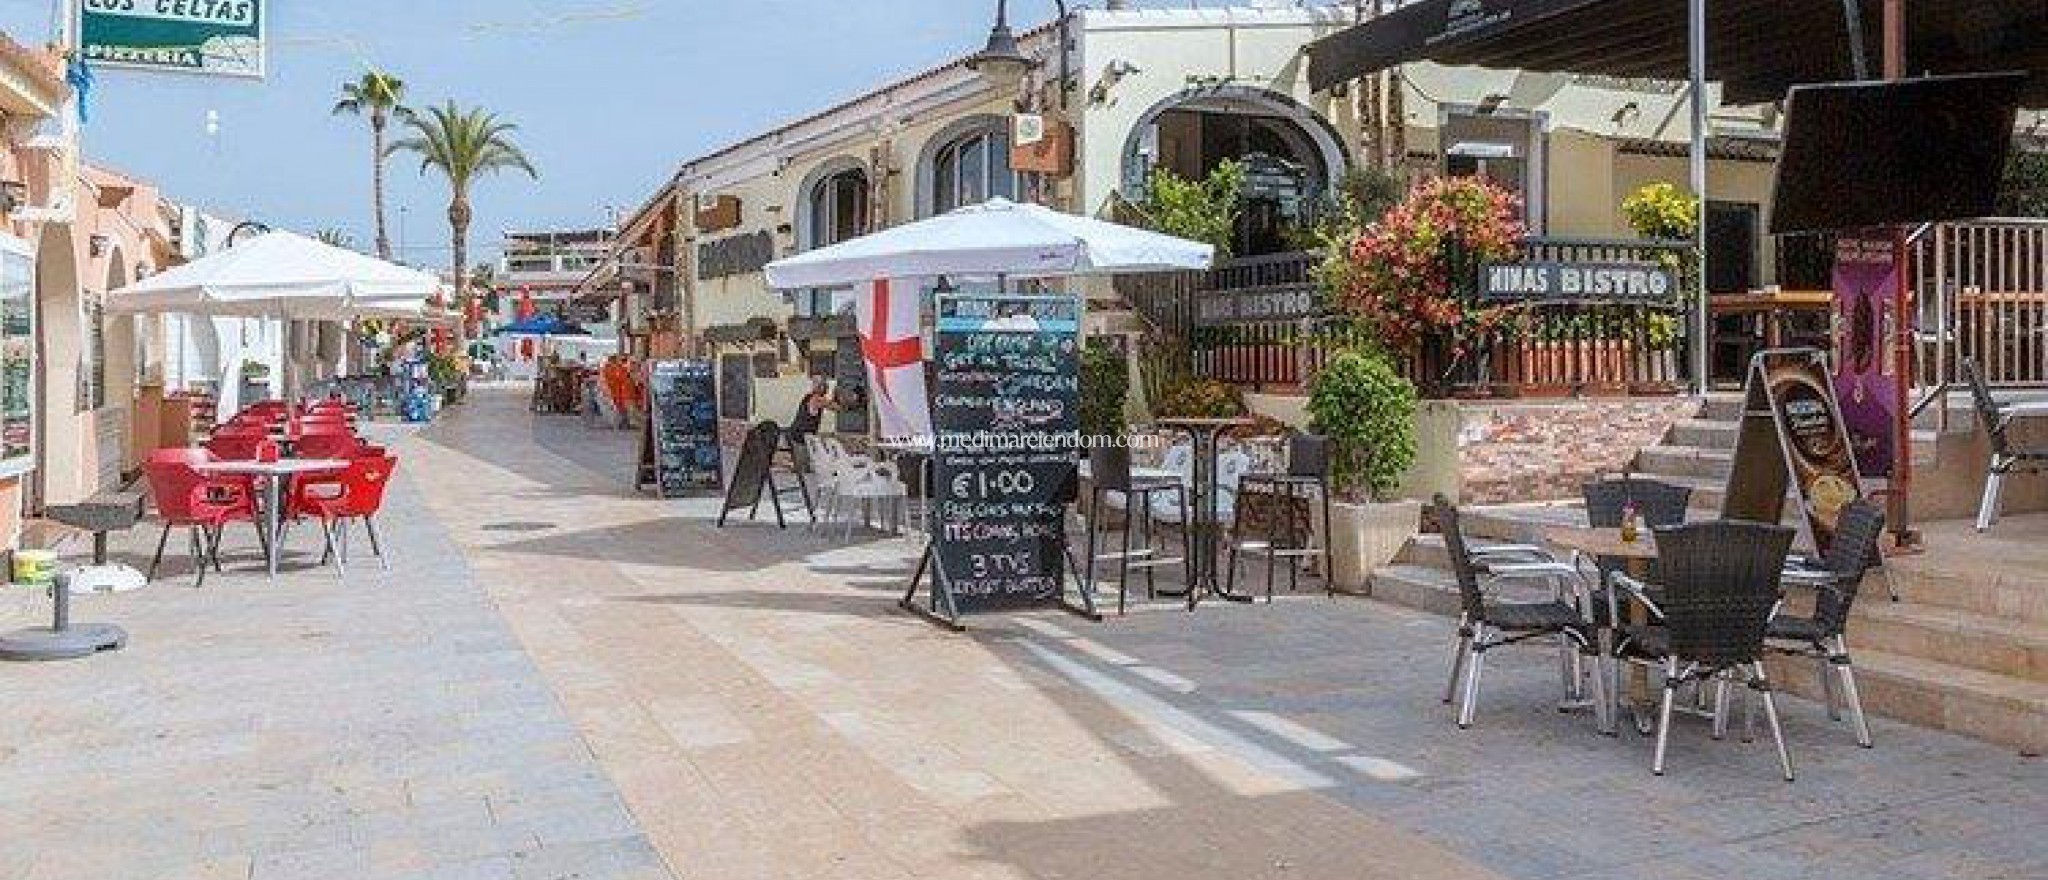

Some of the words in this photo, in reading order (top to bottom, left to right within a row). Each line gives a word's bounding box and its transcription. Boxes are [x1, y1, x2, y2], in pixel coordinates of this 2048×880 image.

[155, 0, 249, 21] CELTAS
[1488, 265, 1549, 292] NINAS
[1560, 267, 1668, 294] BISTRO
[1240, 291, 1311, 316] BISTRO
[970, 554, 988, 578] 3
